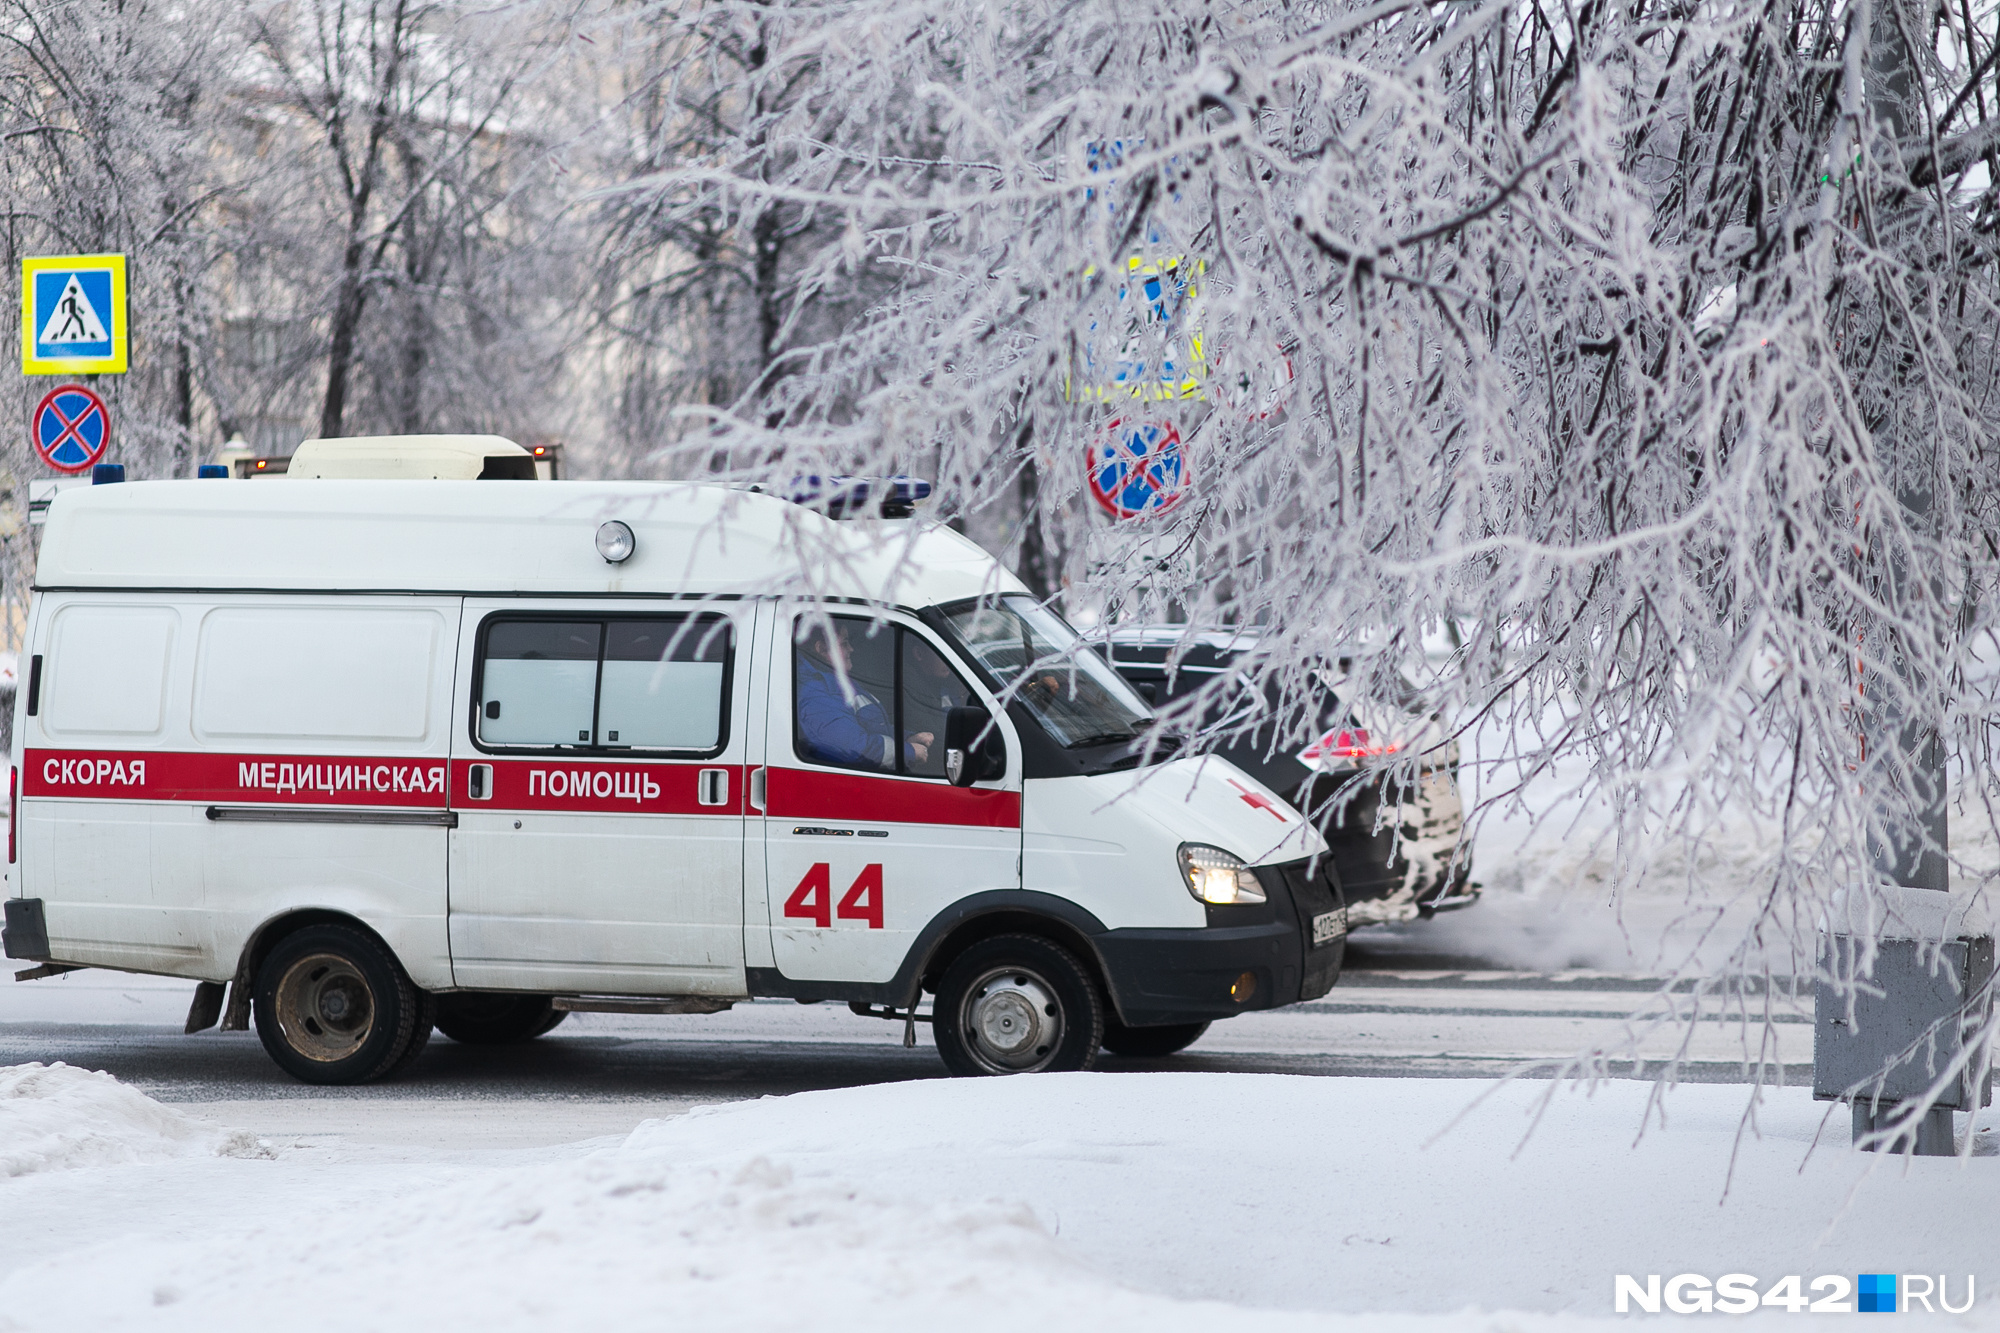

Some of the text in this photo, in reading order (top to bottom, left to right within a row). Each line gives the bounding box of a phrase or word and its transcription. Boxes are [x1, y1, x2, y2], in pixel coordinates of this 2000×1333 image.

[43, 758, 661, 804] СКОРАЯ МЕДИЦИНСКАЯ ПОМОЩЬ
[783, 862, 884, 930] 44
